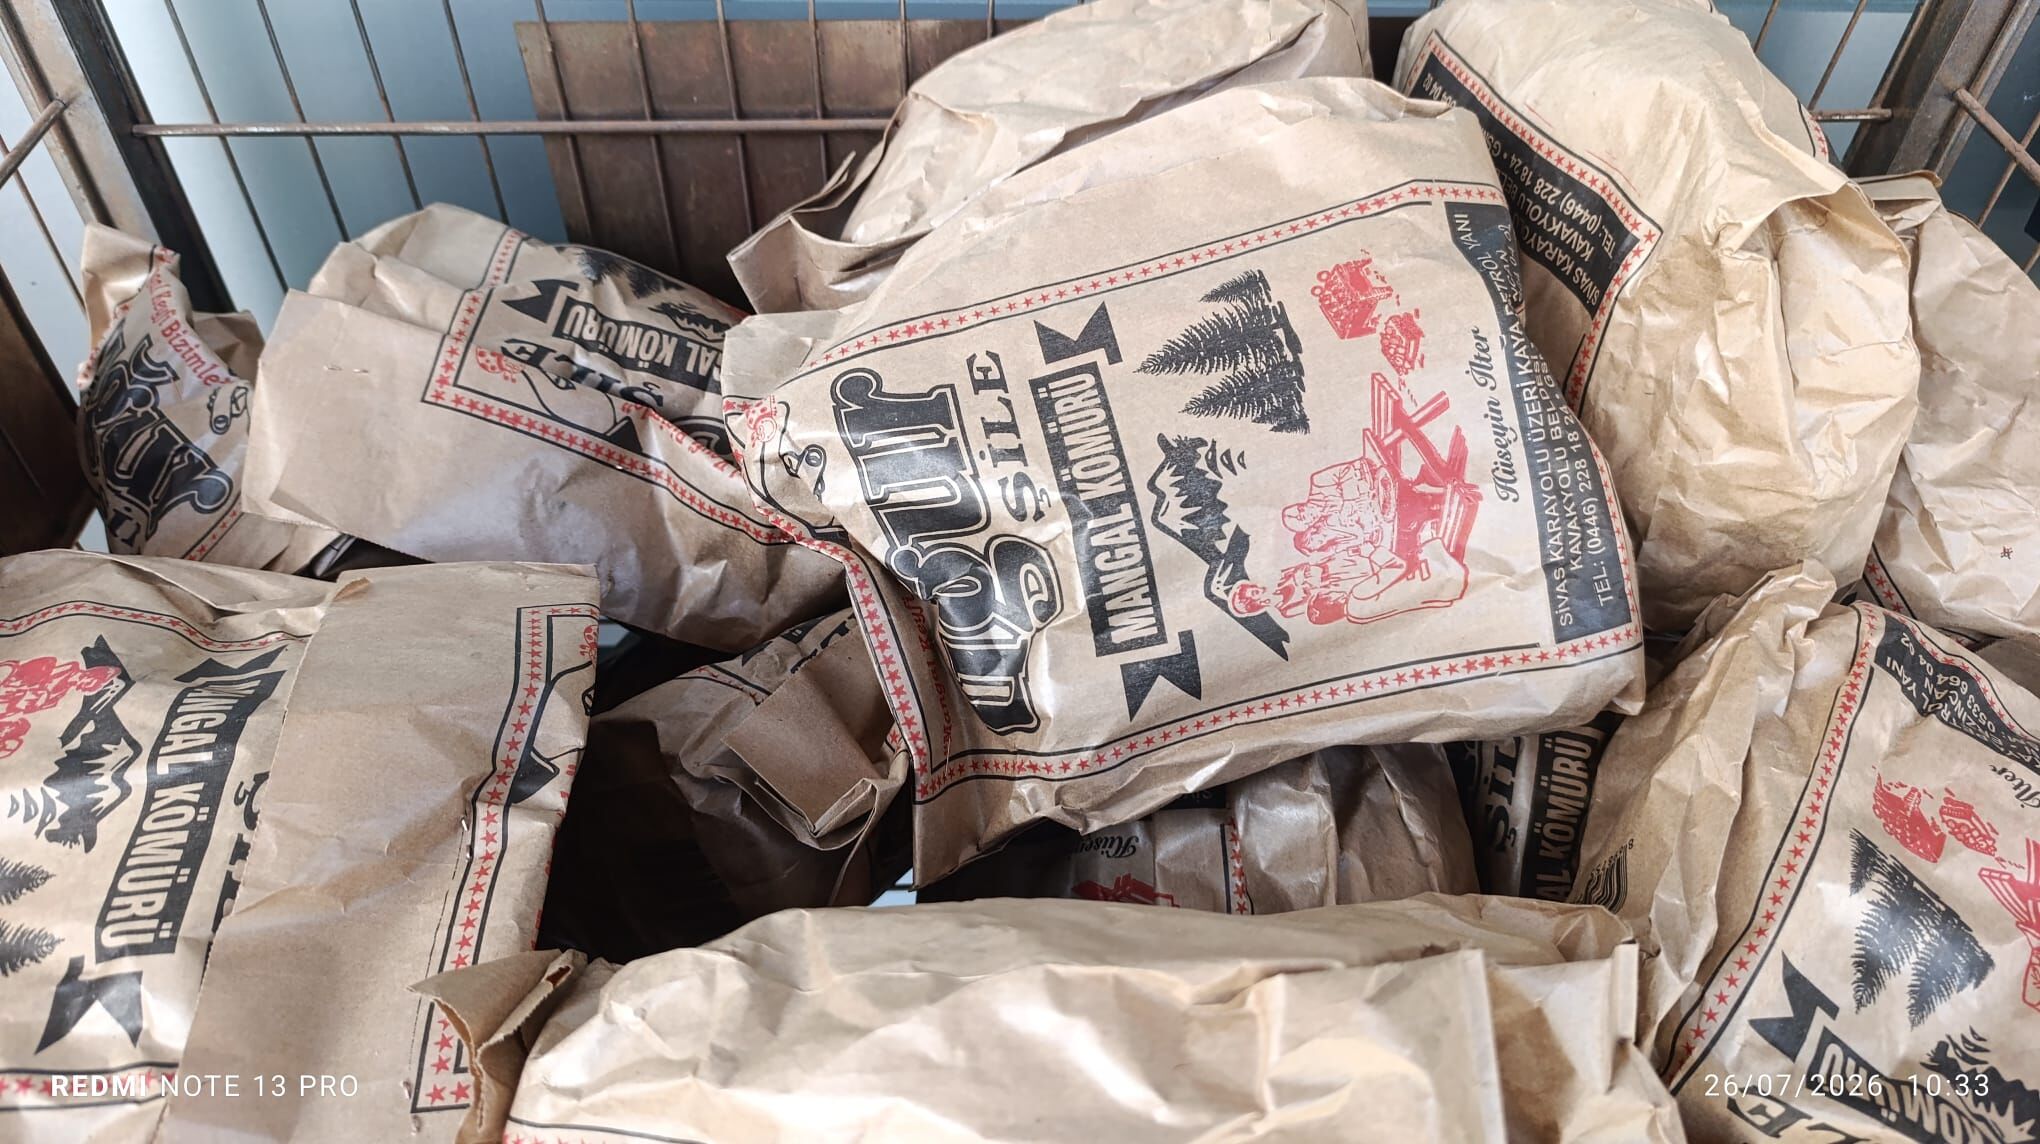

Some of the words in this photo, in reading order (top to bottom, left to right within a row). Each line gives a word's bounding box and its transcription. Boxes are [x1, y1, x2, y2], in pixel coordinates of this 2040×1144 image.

[1509, 153, 1523, 174] 24
[1520, 167, 1533, 186] 18
[1533, 175, 1562, 205] 228
[1453, 213, 1482, 250] YANI
[1517, 194, 1595, 262] KAVAKYOLU
[1559, 191, 1602, 235] (0446)
[1465, 325, 1497, 391] İlter
[1509, 321, 1534, 375] KAYA
[966, 350, 1053, 523] ŞİLE
[1037, 373, 1127, 501] KÖMÜRÜ
[1515, 380, 1546, 442] ÜZERİ
[1560, 404, 1575, 426] 24
[1484, 395, 1520, 503] Hüseyin
[1567, 430, 1583, 453] 18
[1574, 458, 1593, 493] 228
[1535, 449, 1565, 563] KARAYOLU
[1554, 446, 1583, 571] KAVAKYOLU
[1582, 496, 1606, 555] (0446)
[1087, 502, 1158, 644] MANGAL
[1553, 567, 1574, 626] SİVAS
[1592, 560, 1614, 607] TEL:
[1900, 632, 1915, 656] 02
[1919, 654, 1934, 675] 04
[1886, 656, 1917, 697] YANI
[1936, 673, 1969, 693] 664
[1966, 694, 1996, 733] 0533
[1484, 736, 1522, 853] ŞİL
[1534, 736, 1592, 860] KÖMÜRÜ
[100, 782, 210, 948] KÖMÜRÜ
